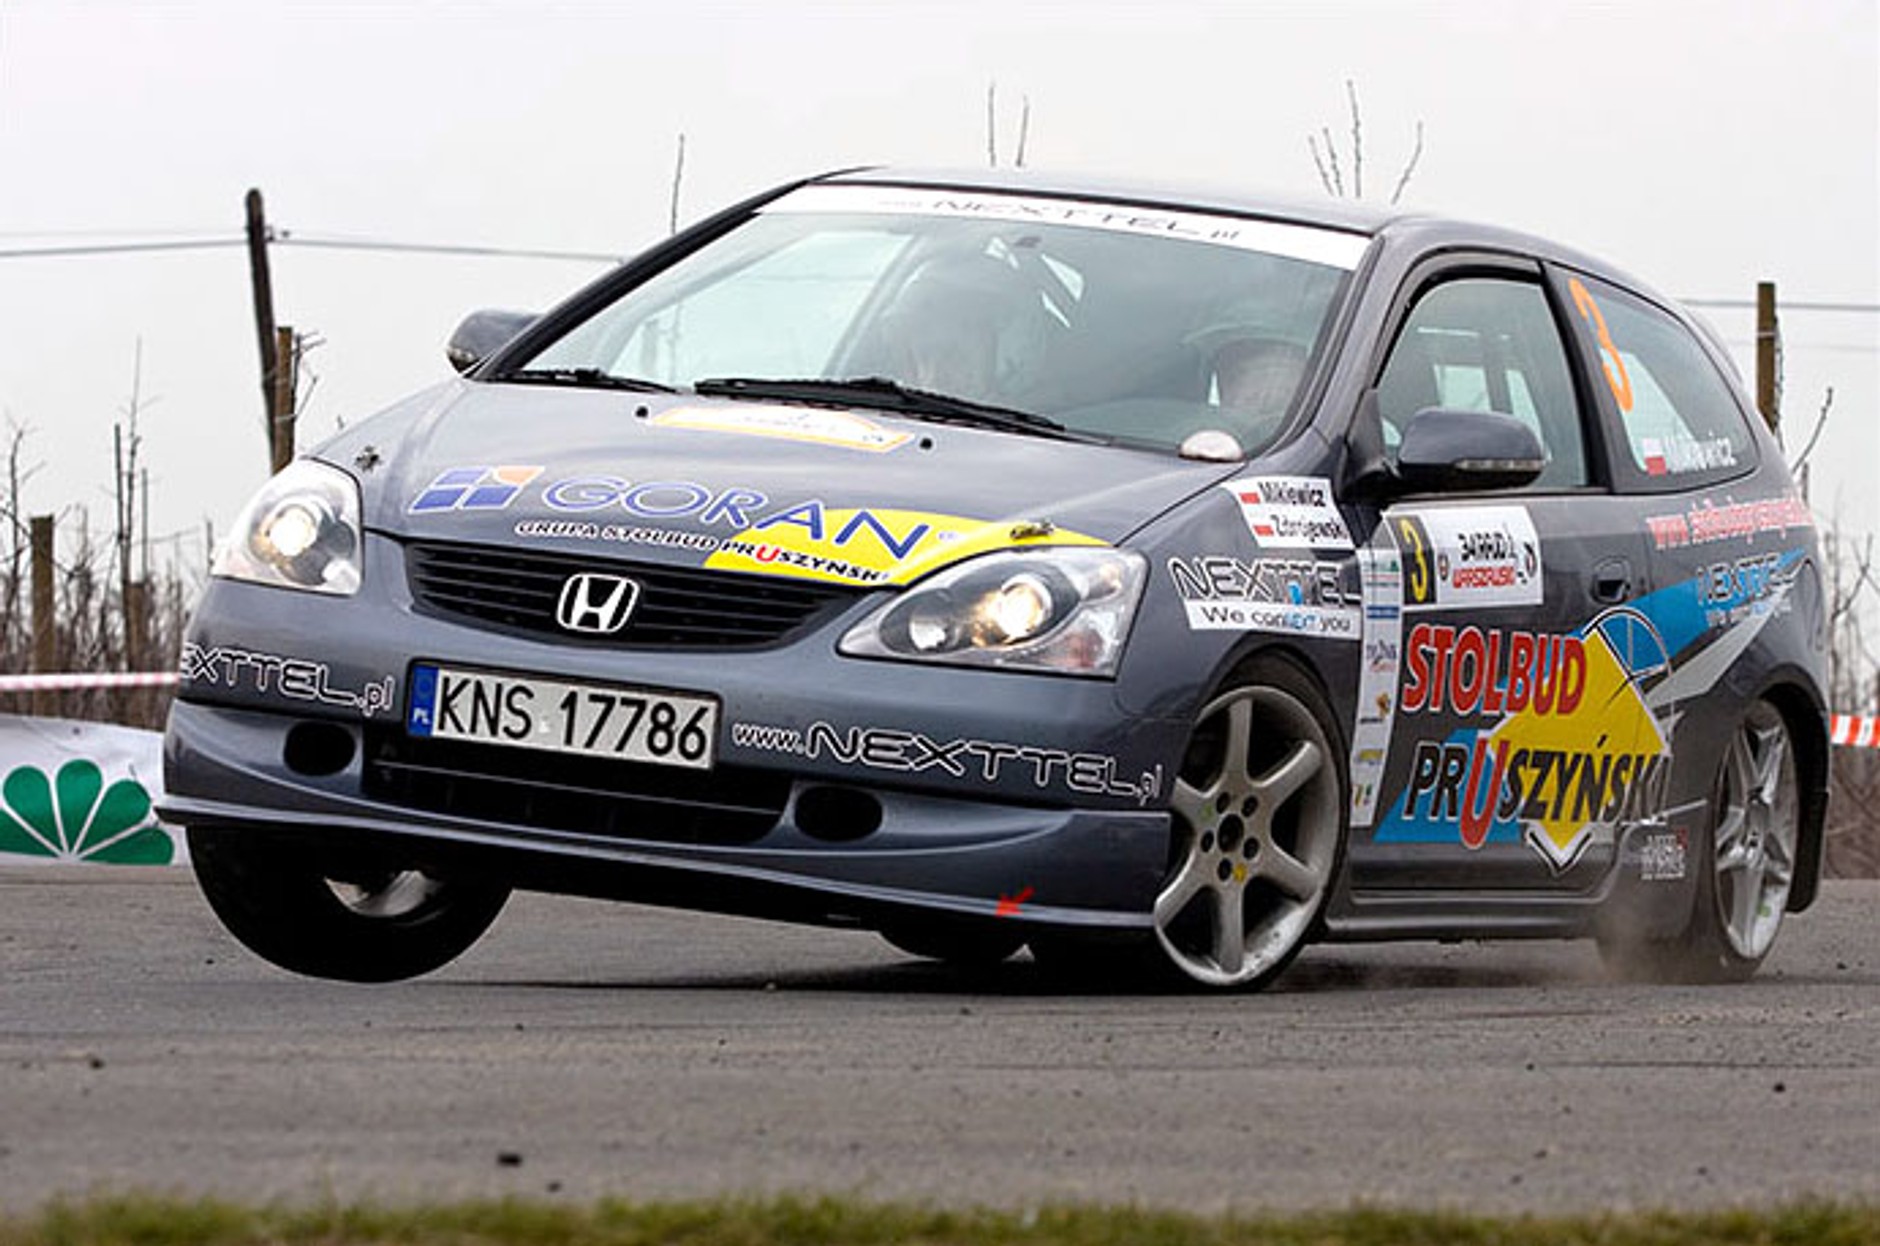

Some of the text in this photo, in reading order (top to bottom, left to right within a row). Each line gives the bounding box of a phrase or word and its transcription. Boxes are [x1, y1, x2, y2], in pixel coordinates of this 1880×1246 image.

[1569, 277, 1634, 412] 3
[515, 519, 599, 540] GRUPA
[601, 524, 719, 551] STOLBUD
[543, 474, 930, 560] GORAN
[1400, 517, 1428, 603] 3
[1200, 605, 1245, 623] We
[1319, 616, 1351, 632] you
[1400, 622, 1587, 715] STOLBUD
[436, 675, 710, 761] KNS 17786
